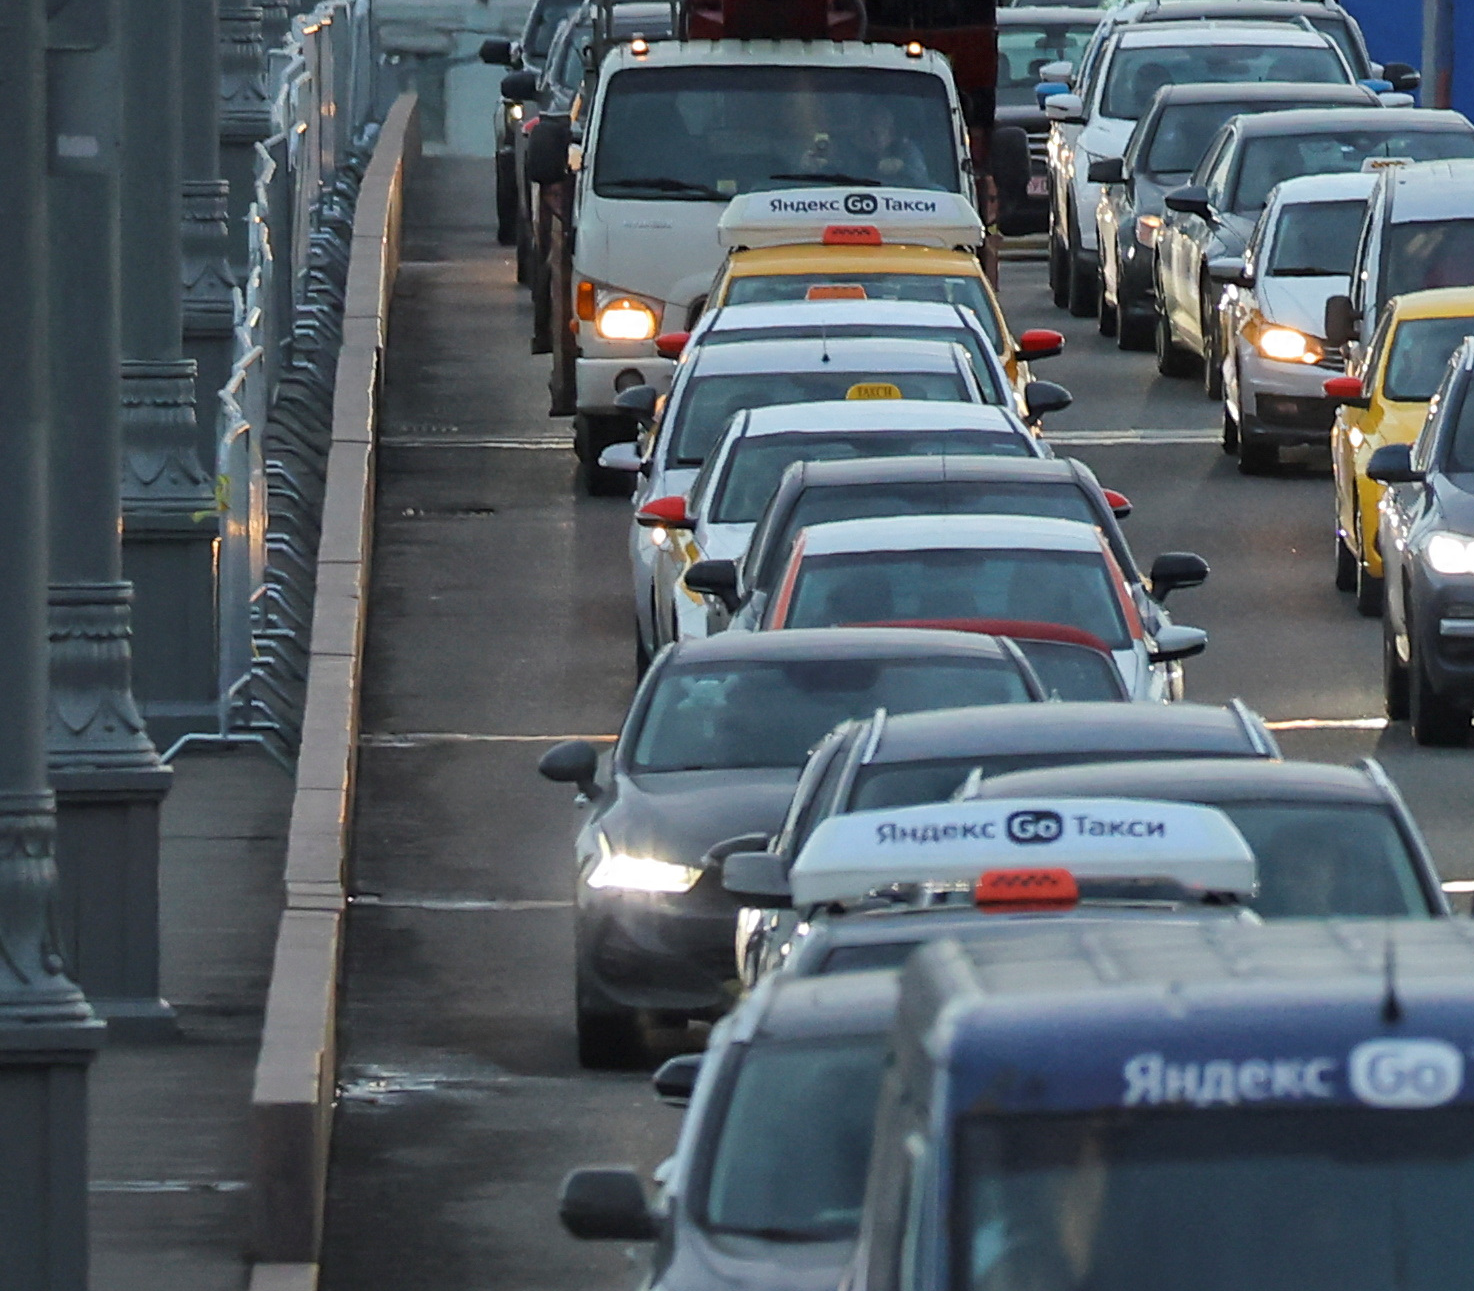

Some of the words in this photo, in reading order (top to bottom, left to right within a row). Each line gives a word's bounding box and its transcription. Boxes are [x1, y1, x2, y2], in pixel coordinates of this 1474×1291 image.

[769, 198, 839, 213] Яндекс
[848, 195, 876, 214] Go
[881, 197, 936, 212] Такси
[876, 821, 995, 845] Яндекс
[1010, 813, 1062, 842] Go
[1074, 816, 1165, 838] Такси
[1124, 1053, 1335, 1105] Яндекс
